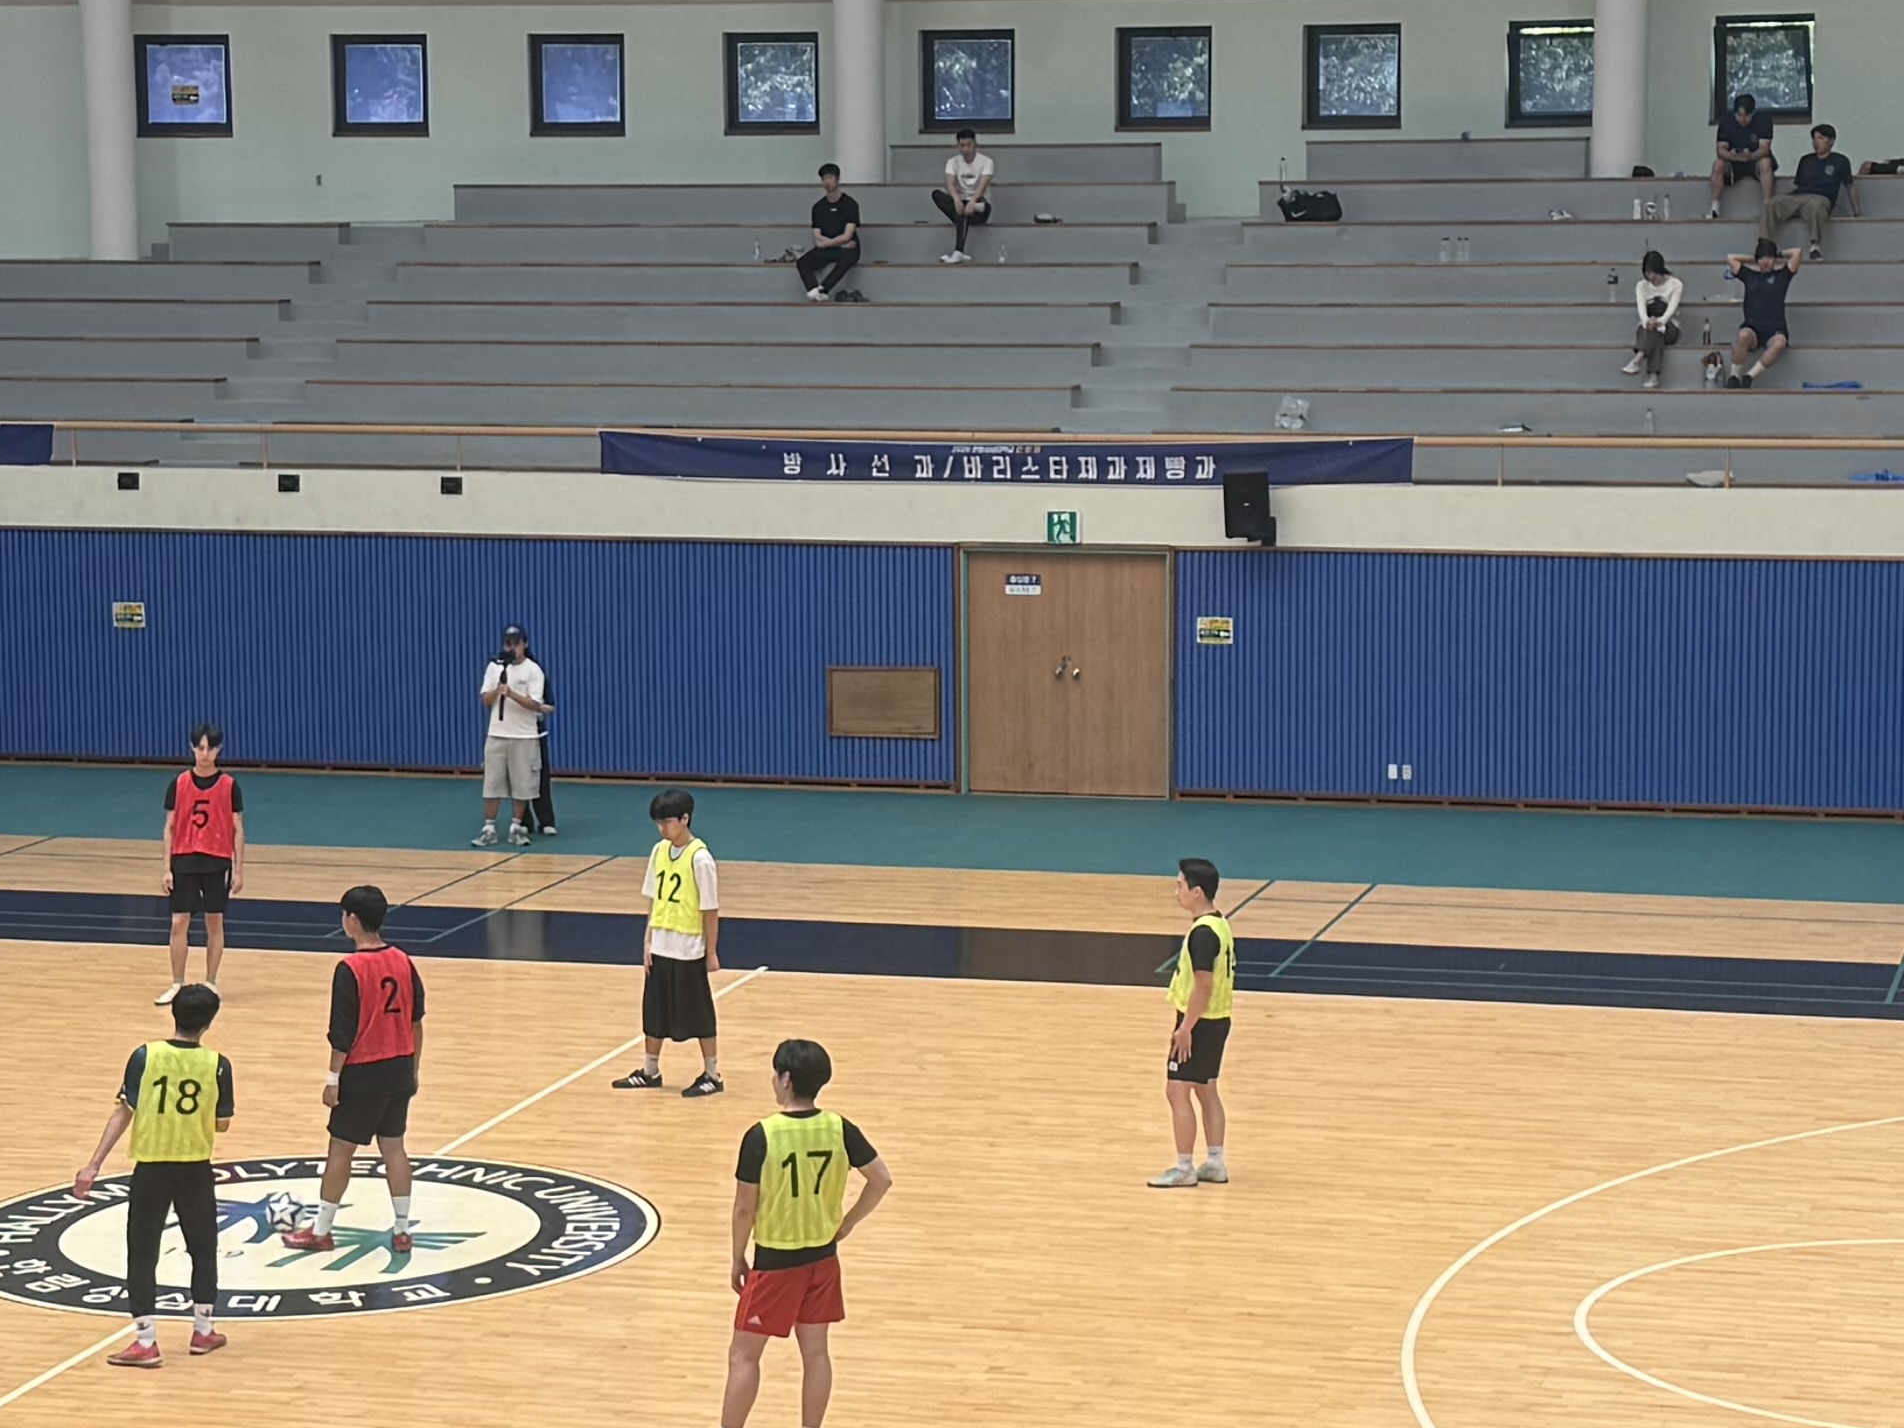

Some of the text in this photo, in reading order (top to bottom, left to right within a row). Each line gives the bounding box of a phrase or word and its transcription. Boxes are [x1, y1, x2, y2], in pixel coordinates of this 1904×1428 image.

[192, 799, 210, 829] 5
[655, 869, 683, 904] 12
[379, 975, 403, 1015] 2
[150, 1074, 202, 1116] 18
[781, 1149, 834, 1199] 17
[506, 1185, 621, 1276] UNIVERSITY
